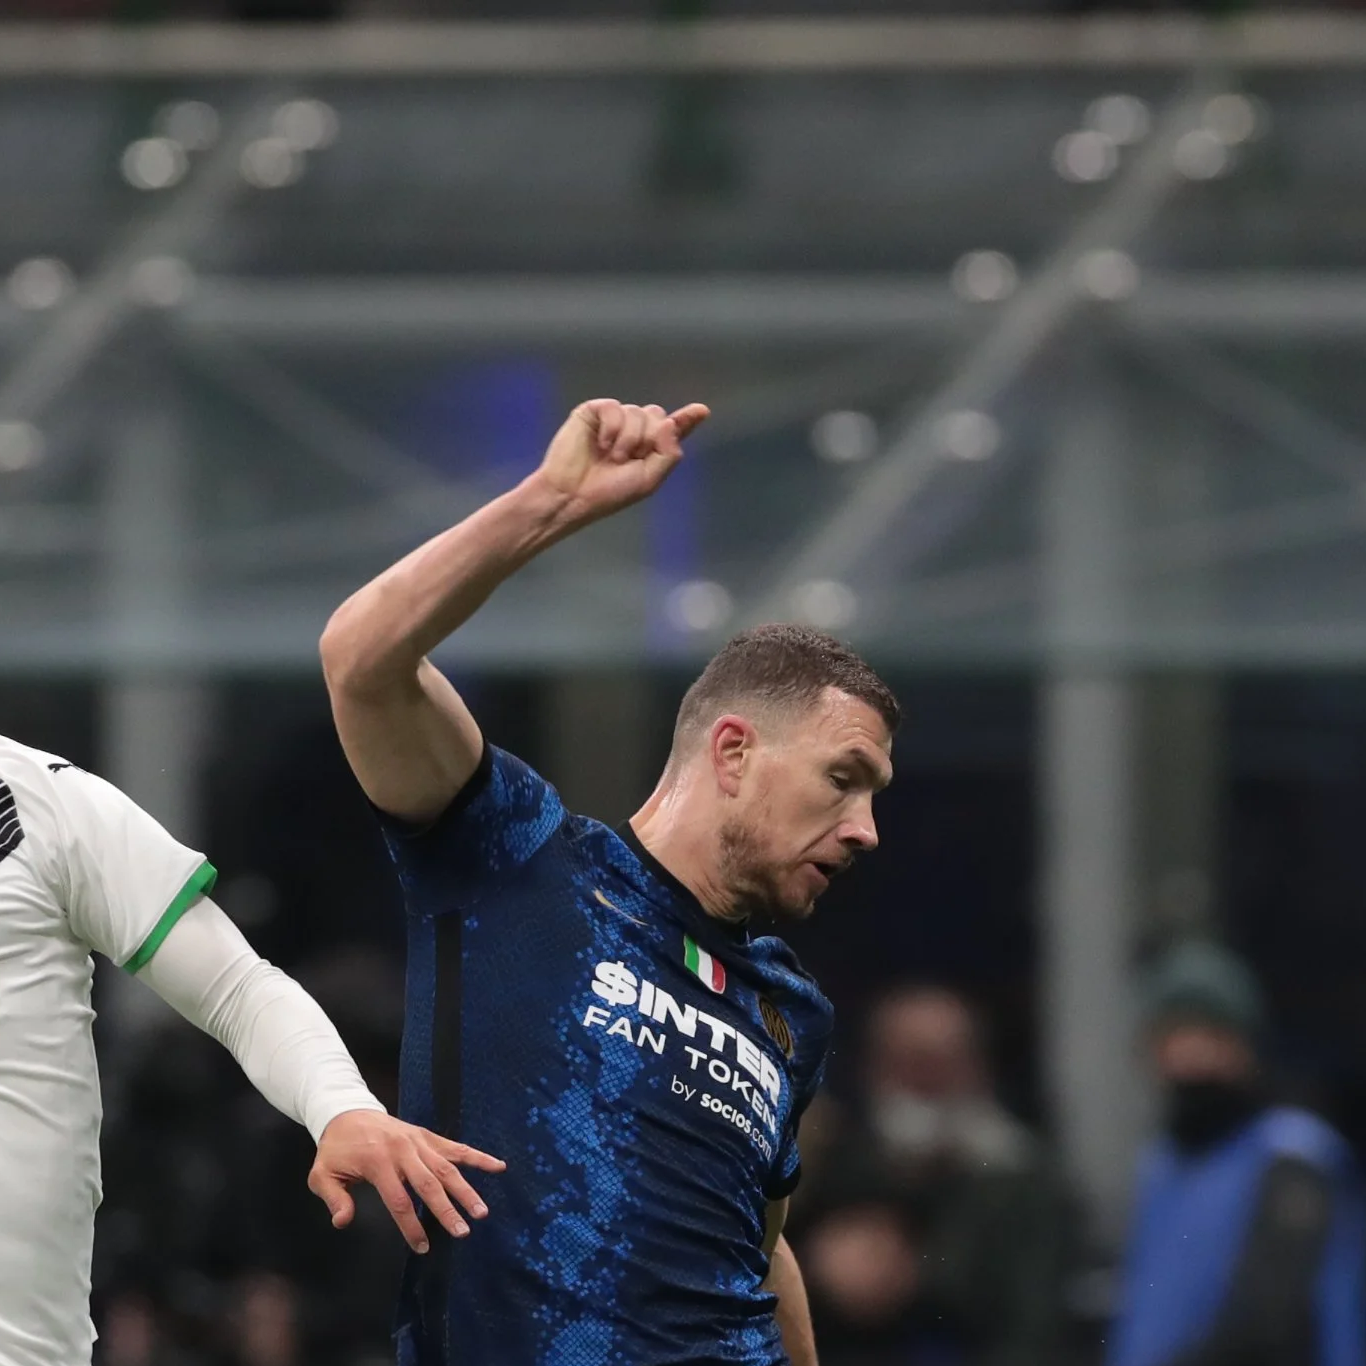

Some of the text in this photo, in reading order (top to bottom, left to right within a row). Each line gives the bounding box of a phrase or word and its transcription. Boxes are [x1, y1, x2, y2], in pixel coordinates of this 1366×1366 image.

[583, 1005, 776, 1134] FAN TOKEN
[591, 961, 781, 1107] $INTER
[671, 1075, 772, 1161] by socios.com
